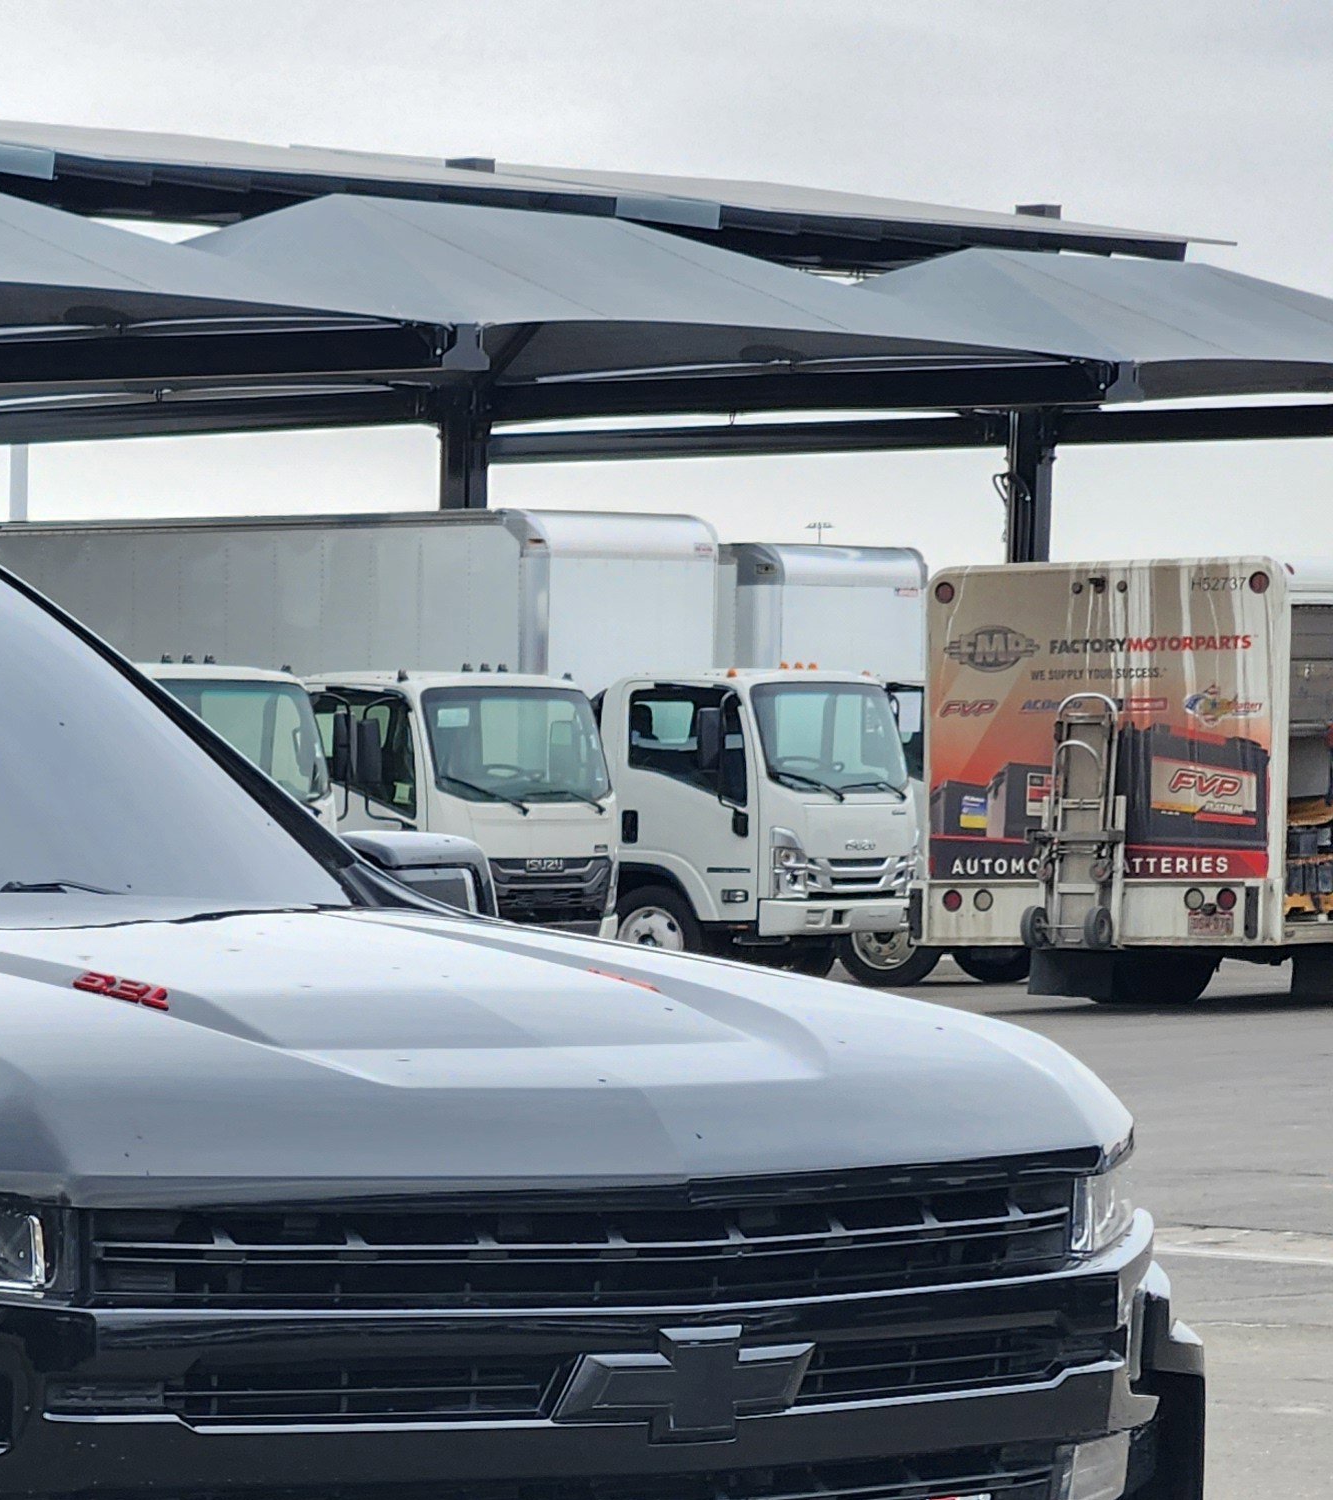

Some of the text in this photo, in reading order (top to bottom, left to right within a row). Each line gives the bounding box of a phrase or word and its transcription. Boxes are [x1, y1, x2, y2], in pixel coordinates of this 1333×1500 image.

[1031, 670, 1046, 681] WE
[1048, 669, 1084, 680] SUPPLY
[939, 700, 998, 718] FVP
[1169, 769, 1242, 798] FVP
